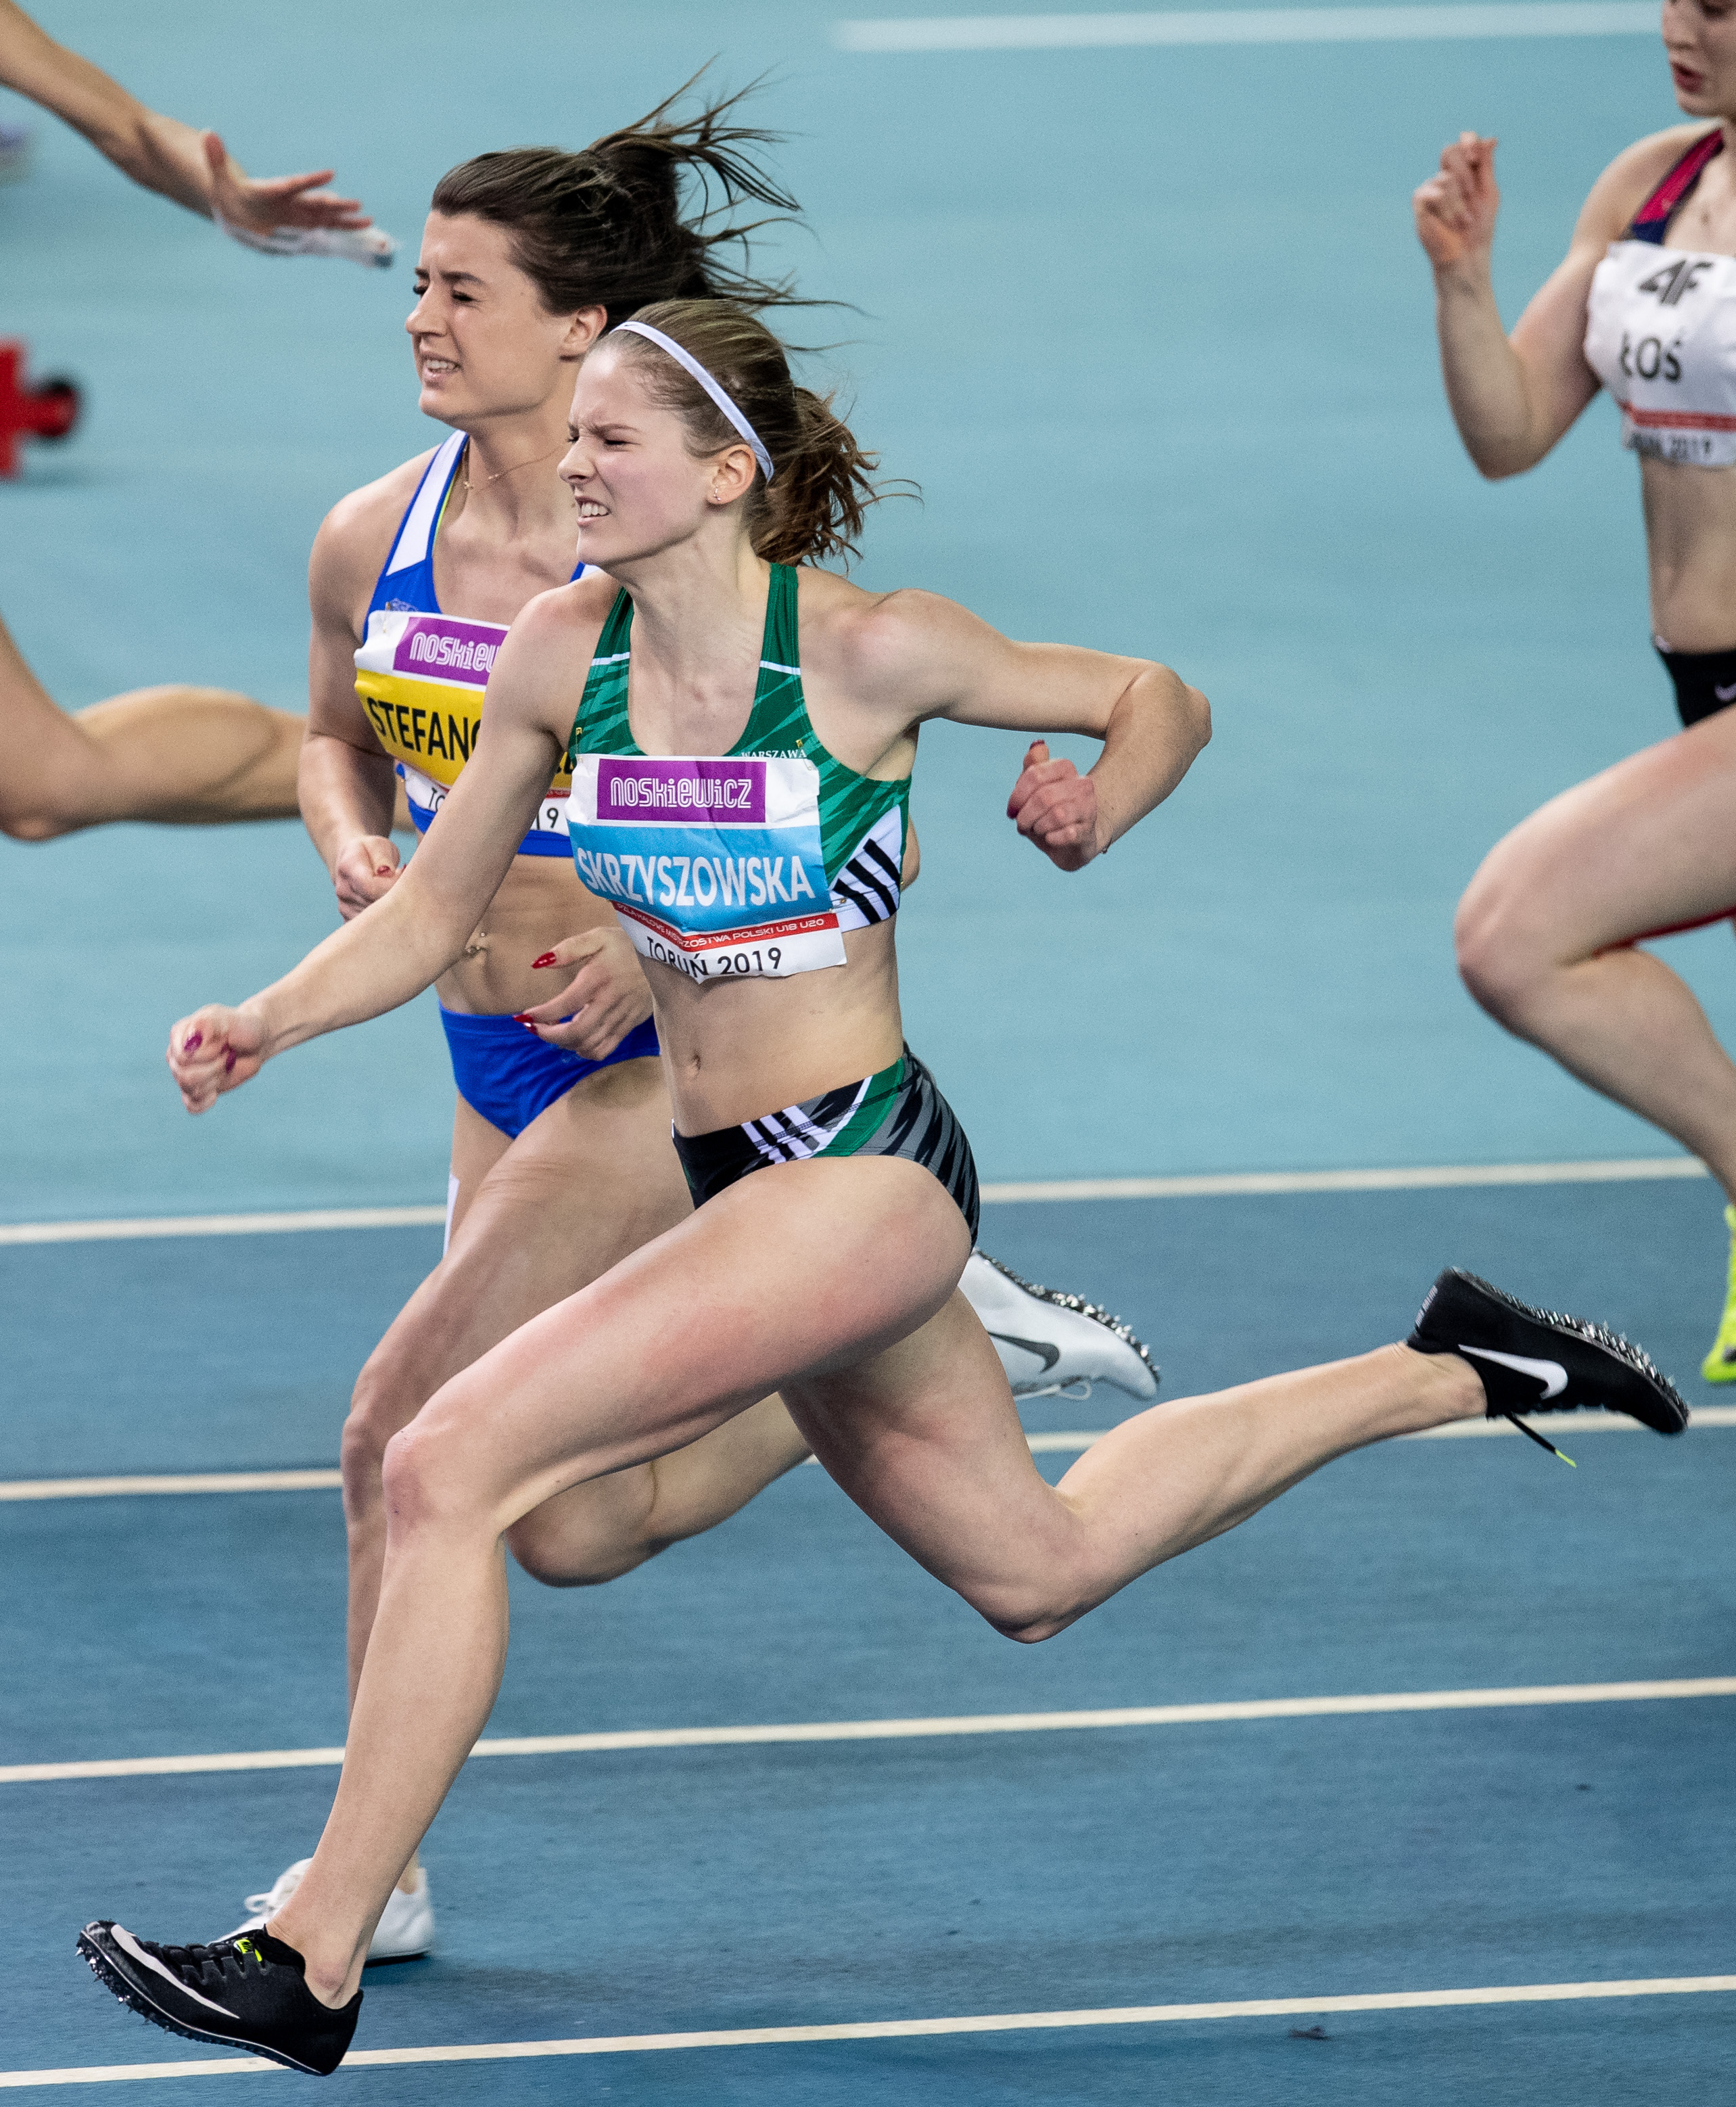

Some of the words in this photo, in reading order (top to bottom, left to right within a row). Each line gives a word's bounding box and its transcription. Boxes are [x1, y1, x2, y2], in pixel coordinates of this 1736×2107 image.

[741, 749, 807, 758] WARSZAWA
[610, 777, 751, 809] noskiewicz
[577, 848, 816, 906] SKRZYSZOWSKA
[732, 927, 774, 940] POLSKI
[776, 922, 797, 933] U18
[799, 918, 824, 929] U20
[647, 936, 709, 977] TORUŃ
[718, 947, 782, 975] 2019
